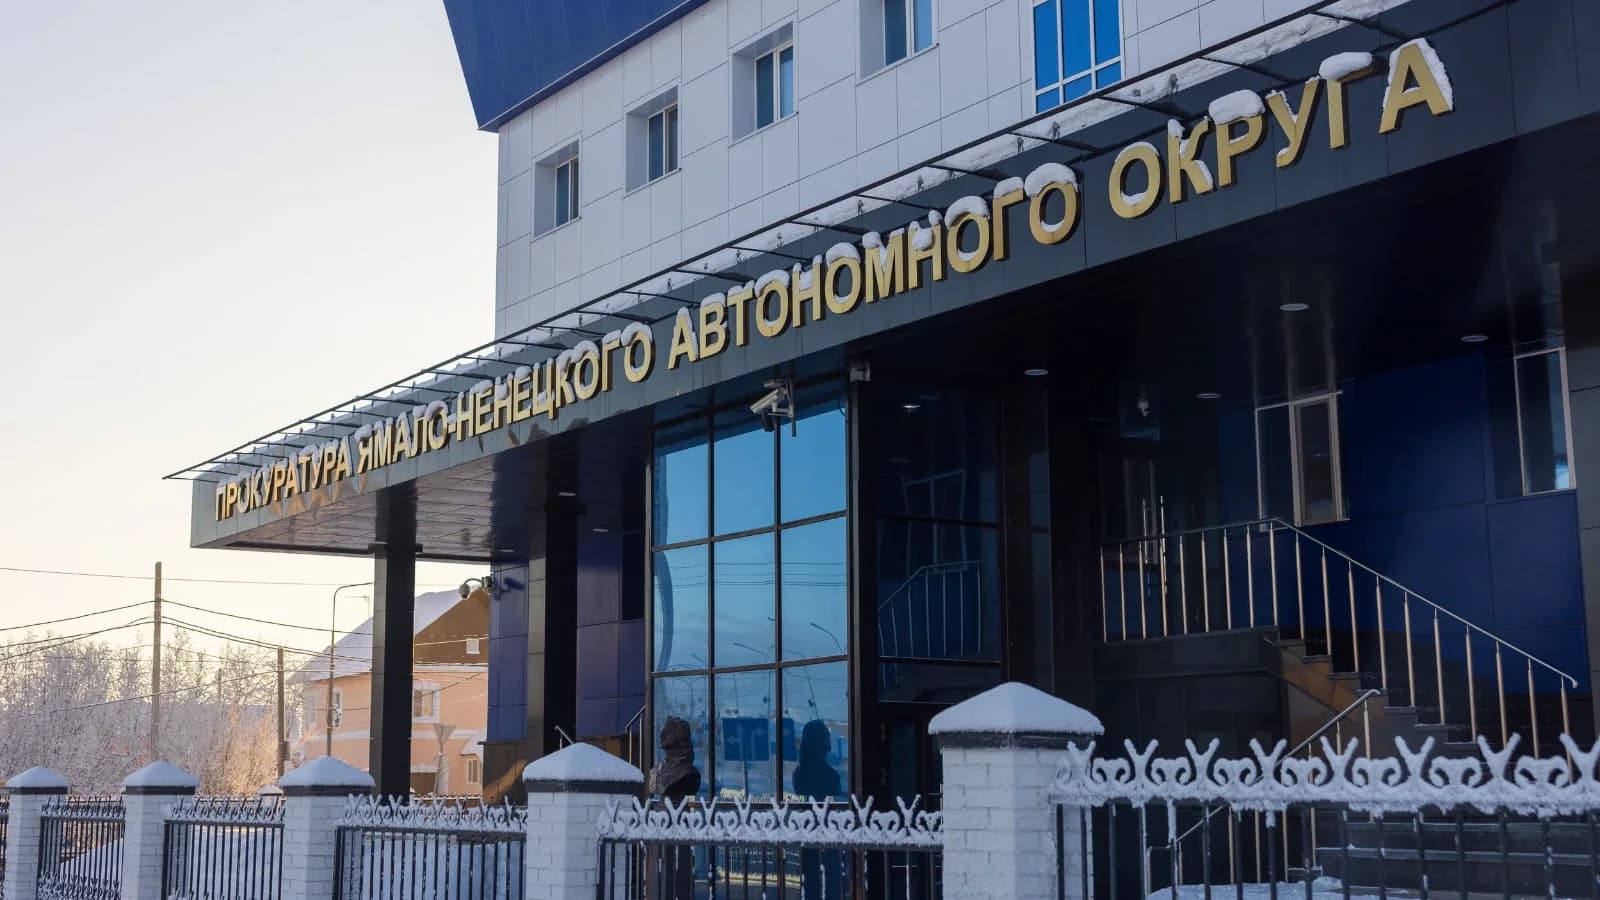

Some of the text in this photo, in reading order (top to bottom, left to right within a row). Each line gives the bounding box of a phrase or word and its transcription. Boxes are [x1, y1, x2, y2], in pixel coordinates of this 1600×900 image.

[215, 38, 1452, 521] ПРОКУРАТУРА ЯМАЛО-НЕНЕЦКОГО АВТОНОМНОГО ОКРУГА
